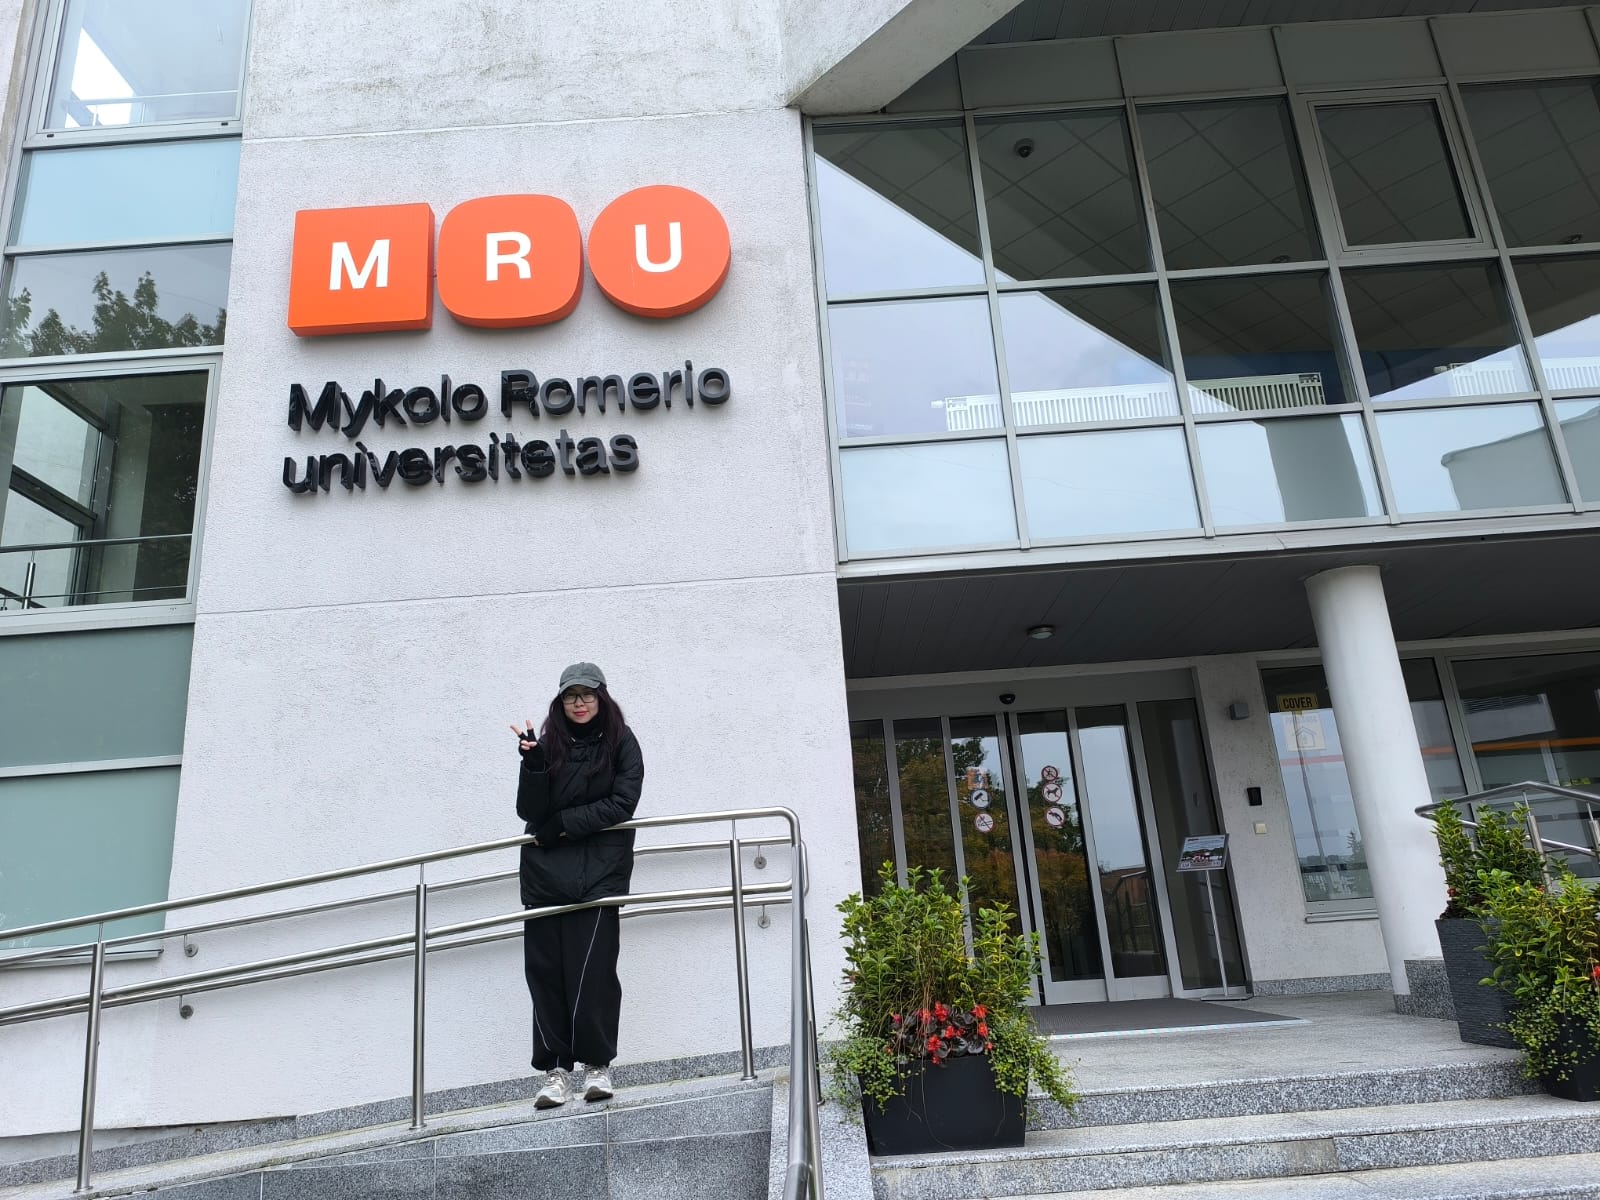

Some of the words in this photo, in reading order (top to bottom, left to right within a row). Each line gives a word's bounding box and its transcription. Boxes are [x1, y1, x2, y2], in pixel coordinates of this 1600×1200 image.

[287, 373, 489, 438] Mykolo
[500, 360, 731, 419] Romerio
[282, 429, 640, 495] universitetas
[1282, 696, 1313, 709] COVER
